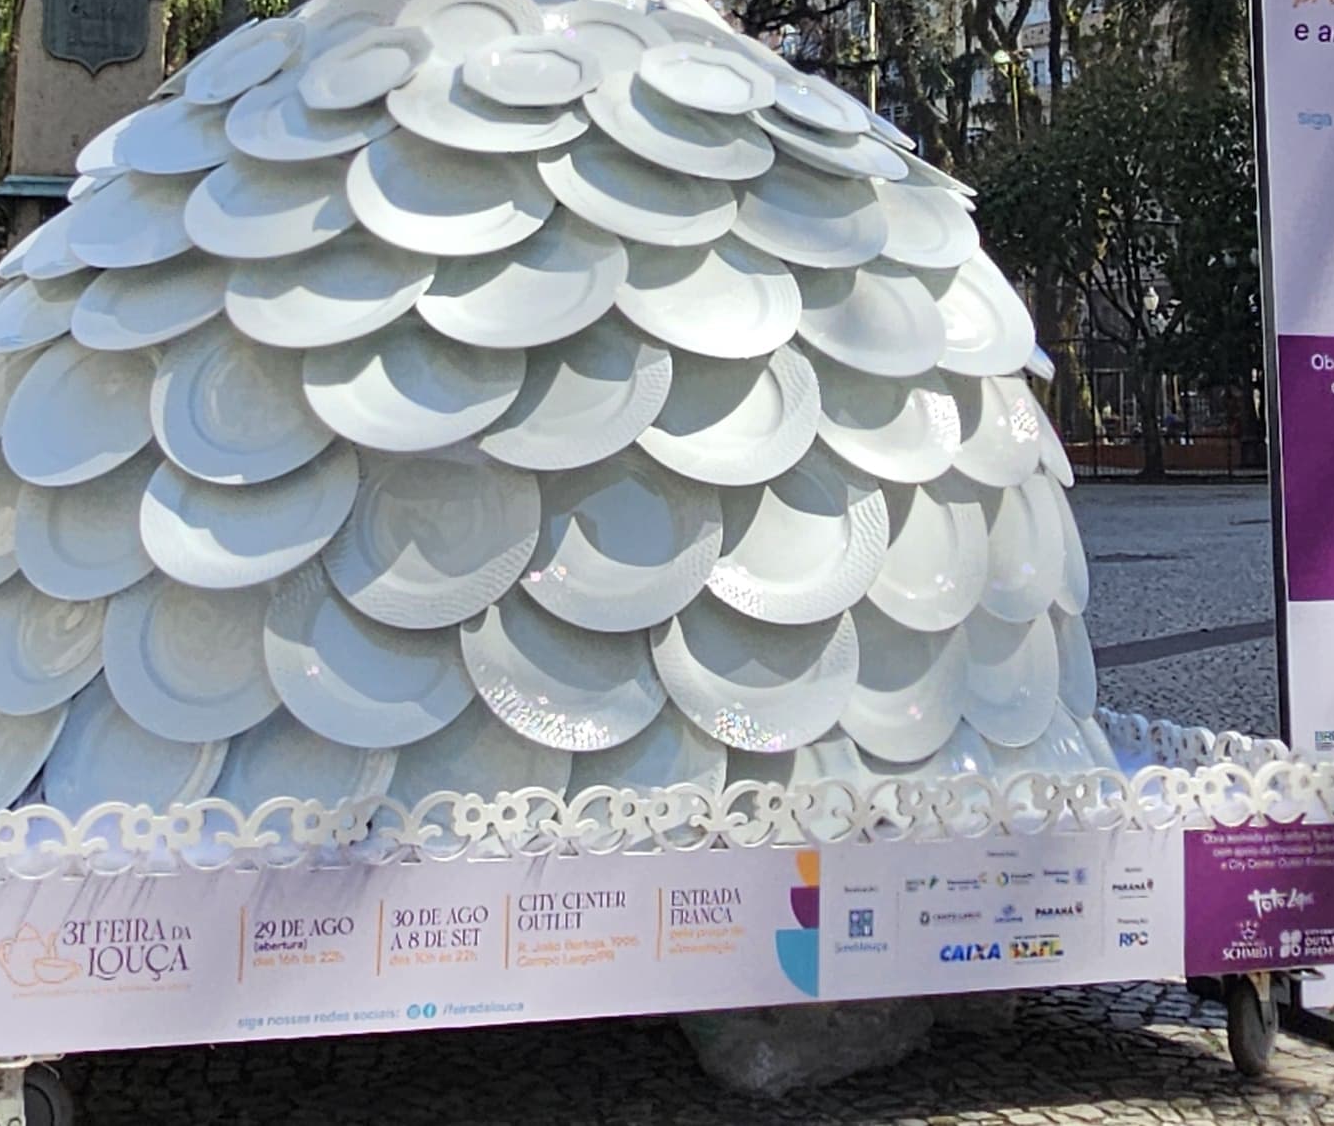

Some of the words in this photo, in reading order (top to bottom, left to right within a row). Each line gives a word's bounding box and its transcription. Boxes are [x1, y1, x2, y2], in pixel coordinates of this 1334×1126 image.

[1294, 23, 1309, 41] e
[1298, 110, 1332, 130] siga
[518, 893, 556, 912] CITY
[562, 890, 626, 910] CENTER
[671, 887, 742, 907] ENTRADA
[393, 909, 414, 927] 30
[419, 908, 441, 926] DE
[447, 905, 489, 925] AGO
[517, 911, 583, 931] OUTLET
[671, 907, 733, 926] FRANCA
[93, 918, 165, 945] FEIRA
[171, 925, 193, 941] DA
[254, 921, 276, 939] 29
[281, 918, 304, 938] DE
[309, 917, 355, 937] AGO
[390, 931, 402, 951] A
[408, 931, 420, 949] 8
[425, 929, 447, 948] DE
[451, 927, 482, 947] SET
[88, 943, 190, 981] LOUÇA
[940, 943, 1002, 962] CAIXA
[238, 1016, 265, 1031] siga
[314, 1010, 350, 1025] redes
